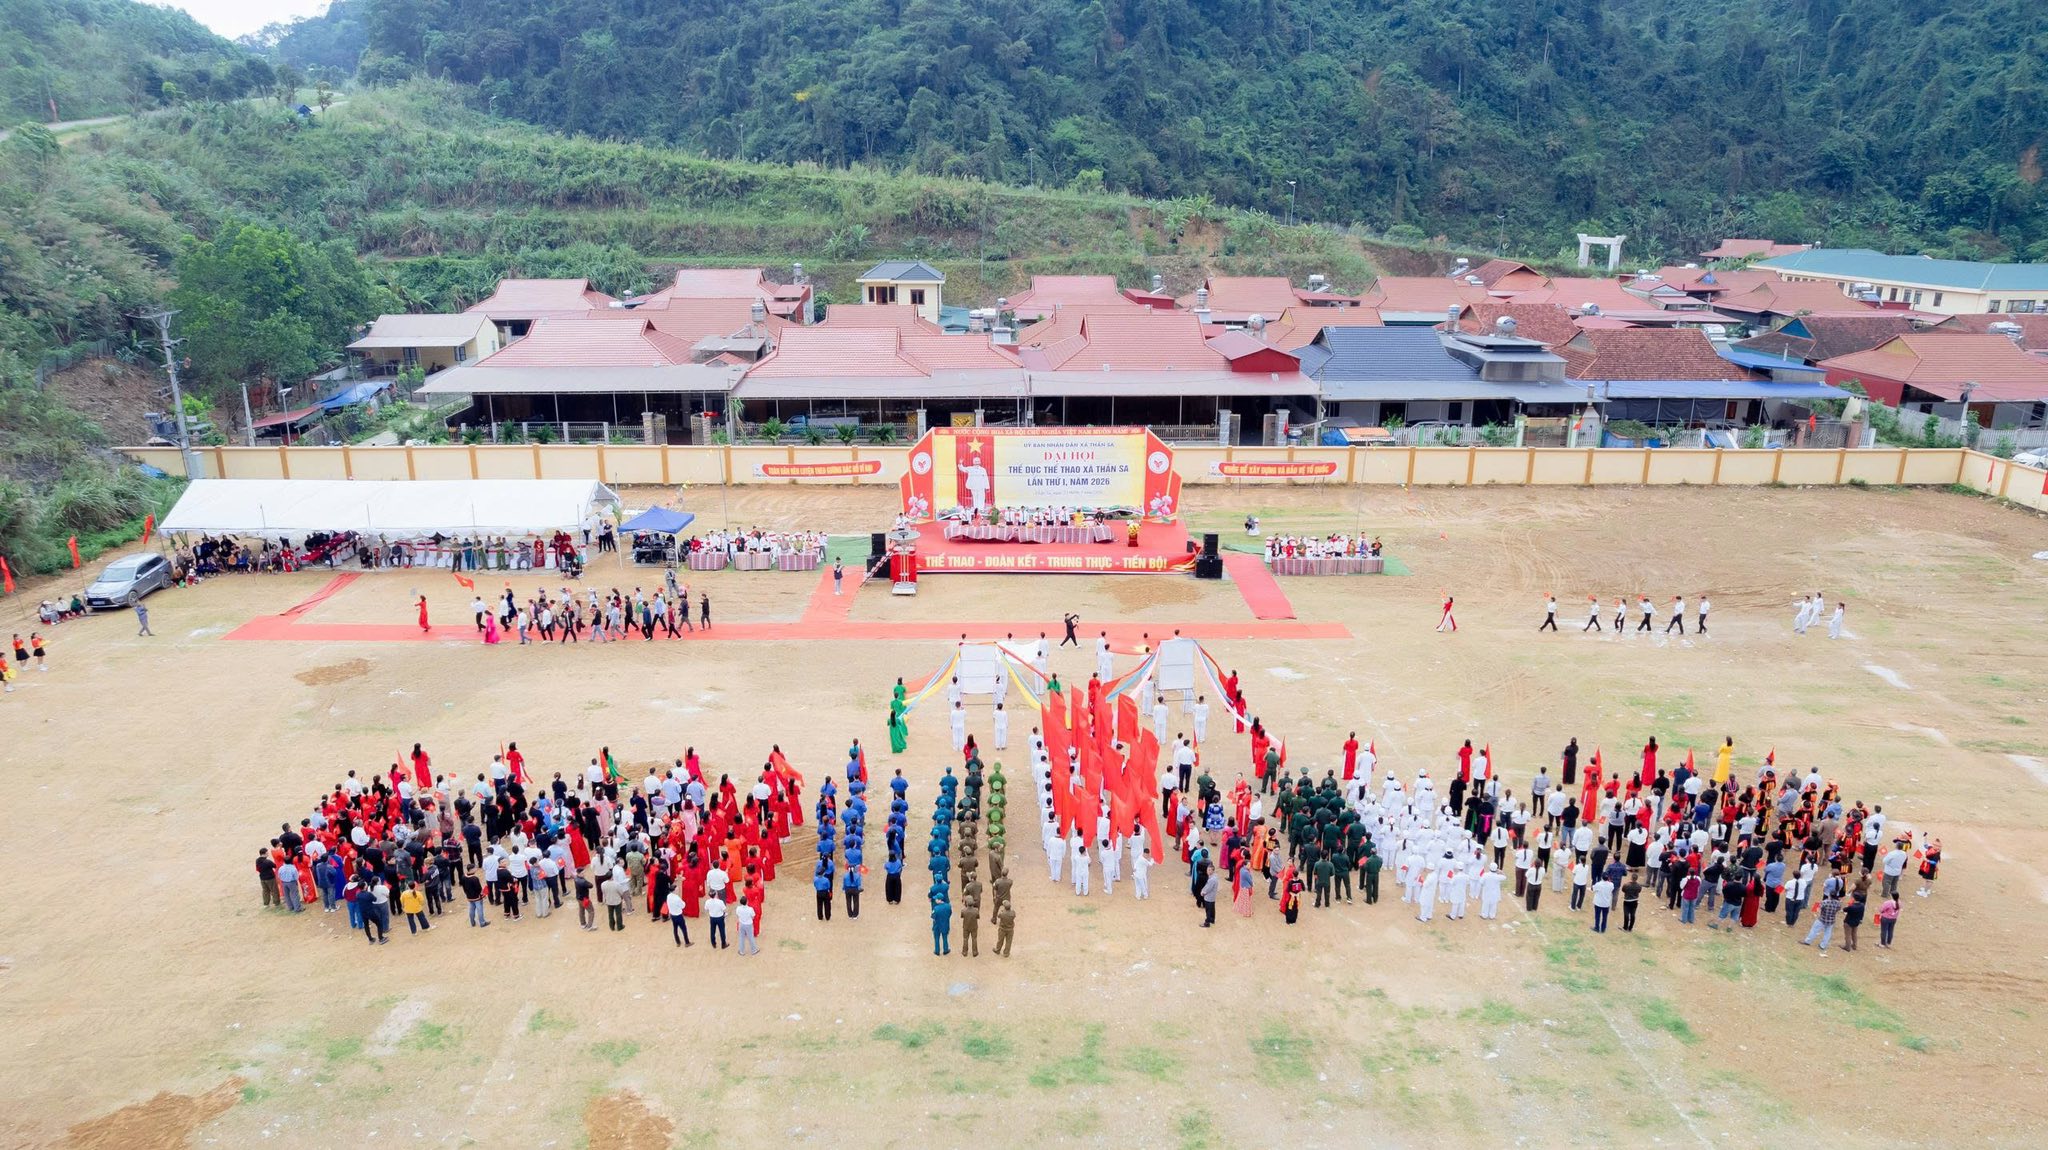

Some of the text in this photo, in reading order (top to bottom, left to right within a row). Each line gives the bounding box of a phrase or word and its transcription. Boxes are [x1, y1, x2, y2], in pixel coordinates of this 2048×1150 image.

[947, 556, 975, 567] THAO
[985, 554, 1014, 567] ĐOÀN
[1018, 554, 1038, 567] KẾT
[1047, 556, 1082, 568] TRUNG
[1084, 556, 1112, 570] THỰC
[1122, 554, 1146, 568] TIẾN
